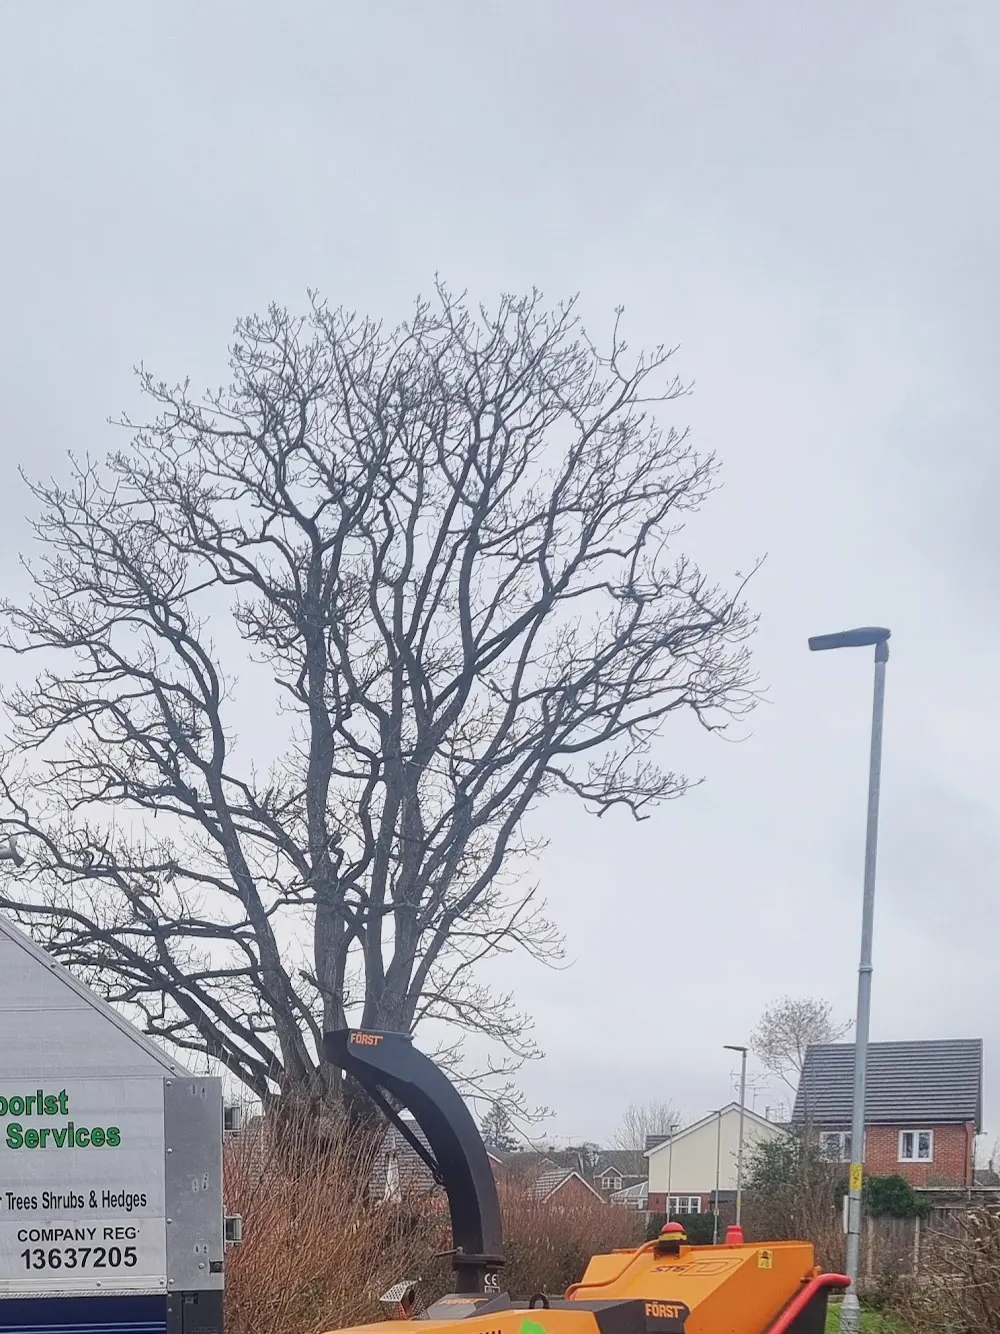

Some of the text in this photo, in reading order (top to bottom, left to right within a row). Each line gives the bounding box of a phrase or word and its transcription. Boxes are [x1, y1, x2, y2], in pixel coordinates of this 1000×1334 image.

[5, 1121, 121, 1150] Services
[6, 1191, 38, 1211] Trees
[42, 1190, 85, 1210] Shrubs
[89, 1190, 99, 1209] &
[102, 1189, 147, 1213] Hedges
[17, 1227, 97, 1243] COMPANY
[19, 1245, 138, 1270] 13637205
[645, 1302, 685, 1318] FÖRST
